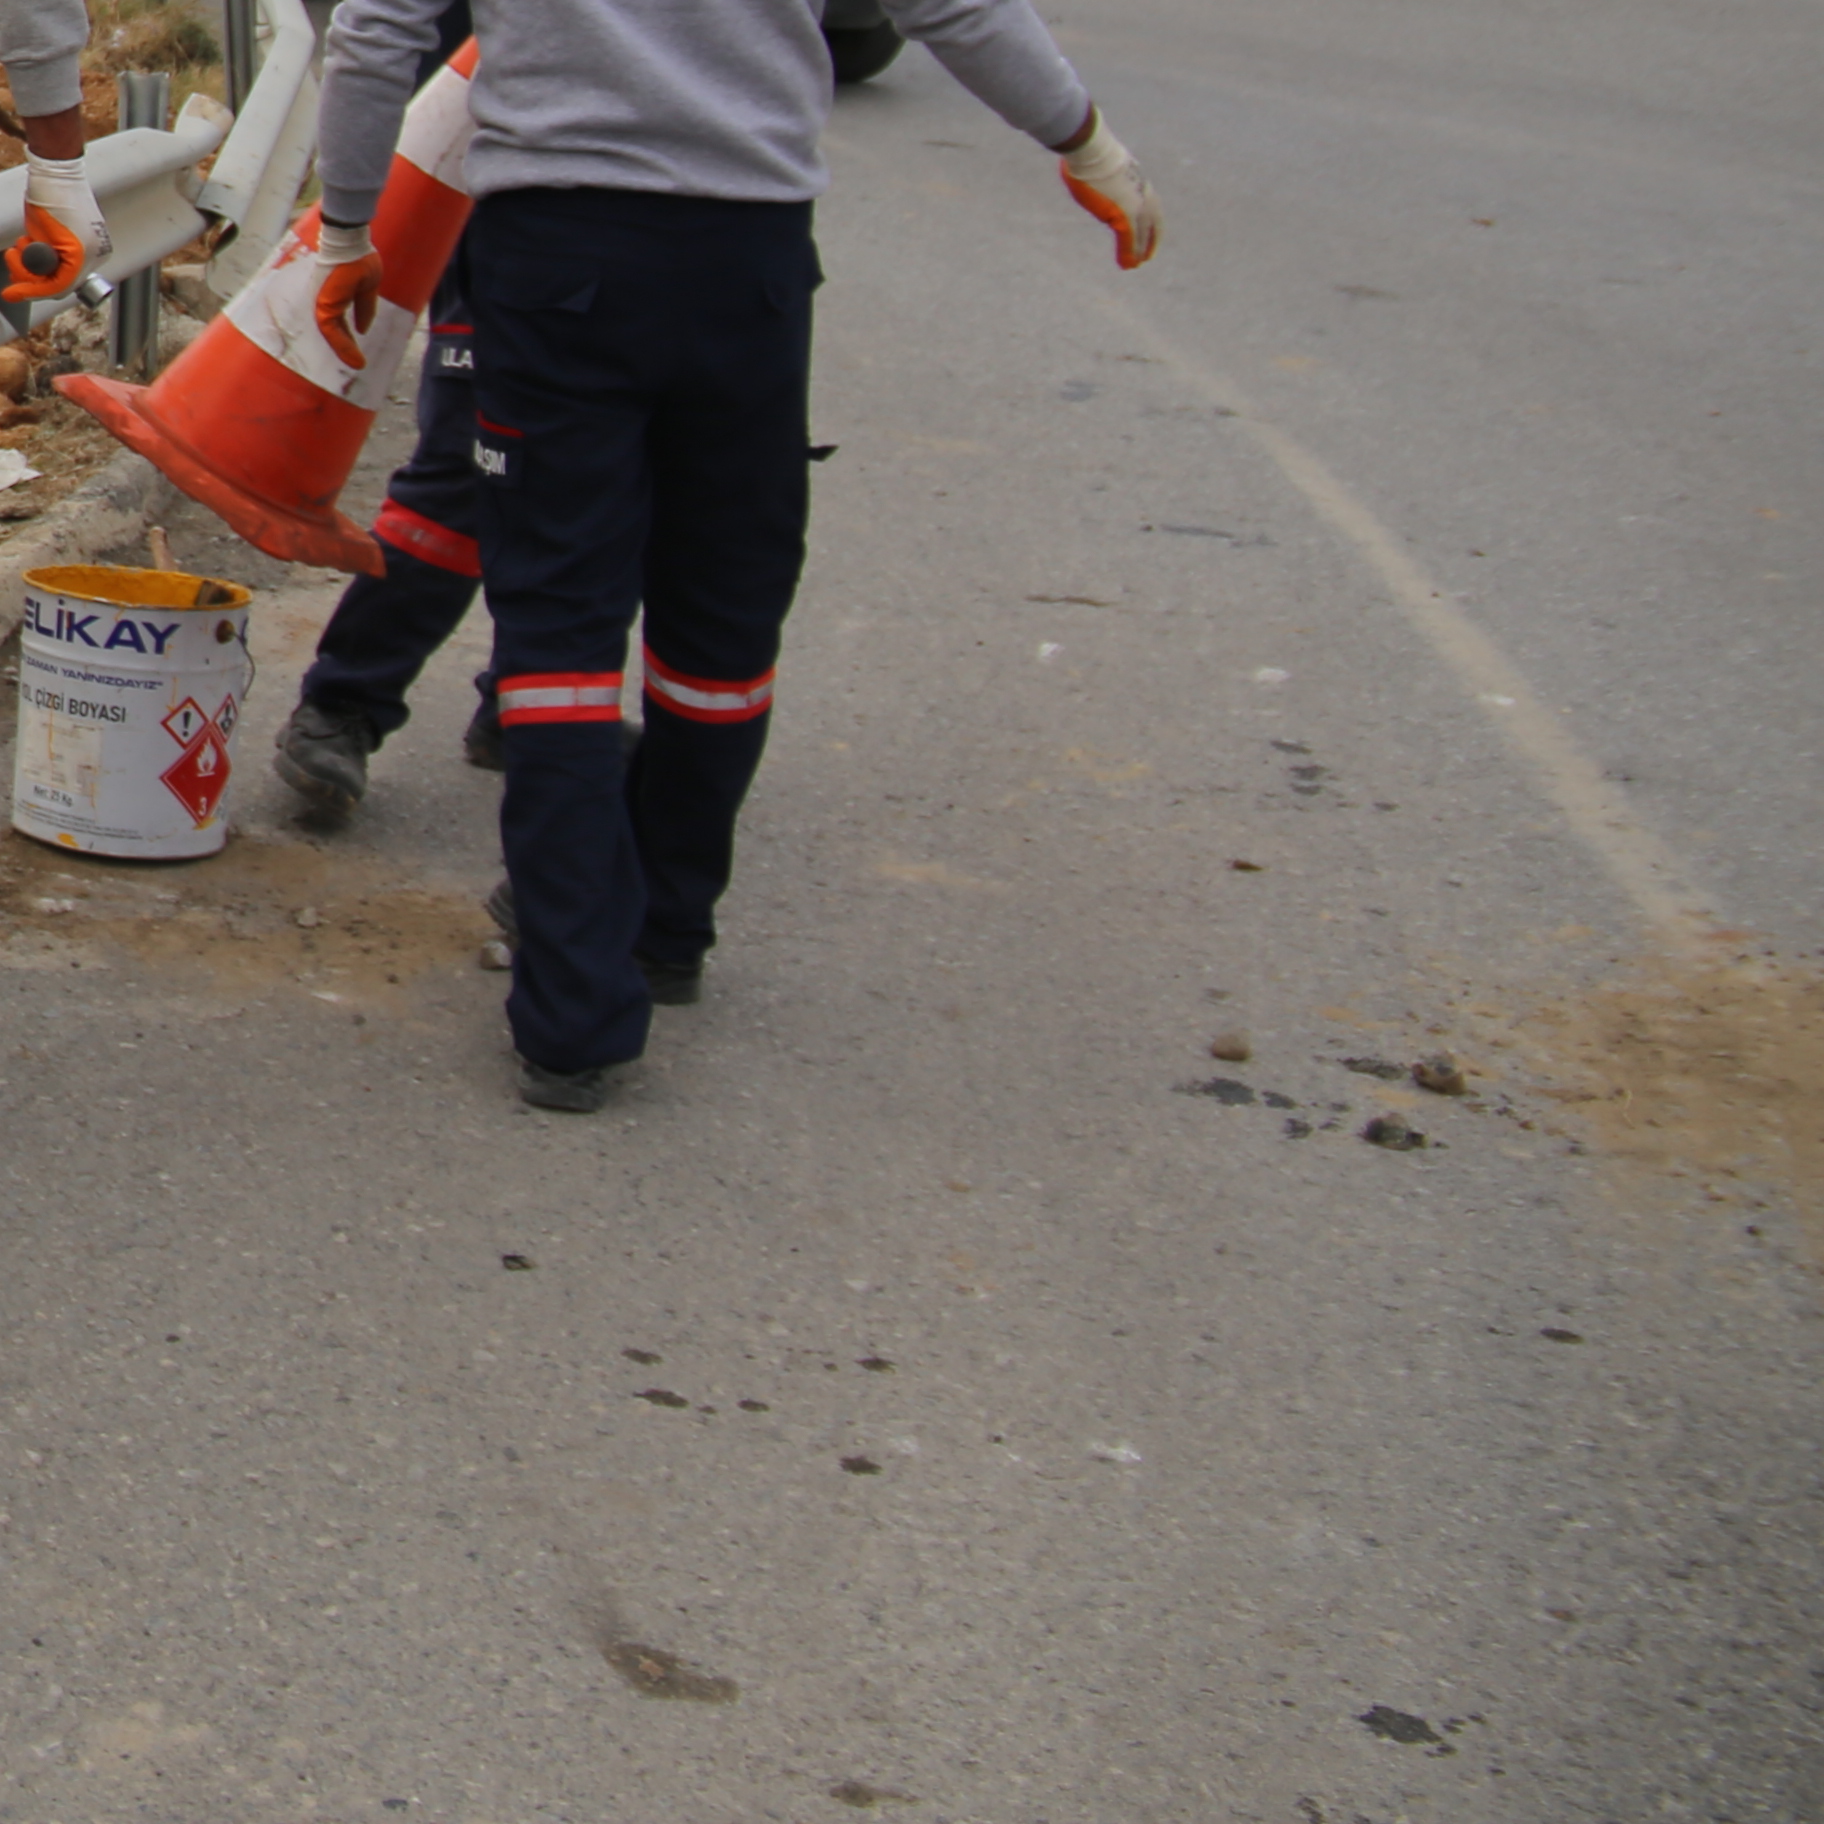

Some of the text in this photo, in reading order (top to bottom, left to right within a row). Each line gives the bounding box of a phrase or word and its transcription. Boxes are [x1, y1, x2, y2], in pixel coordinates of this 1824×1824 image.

[25, 655, 58, 675] ZAMAN
[35, 687, 65, 712] ÇİZGİ
[68, 698, 127, 724] BOYASI
[198, 796, 208, 817] 3
